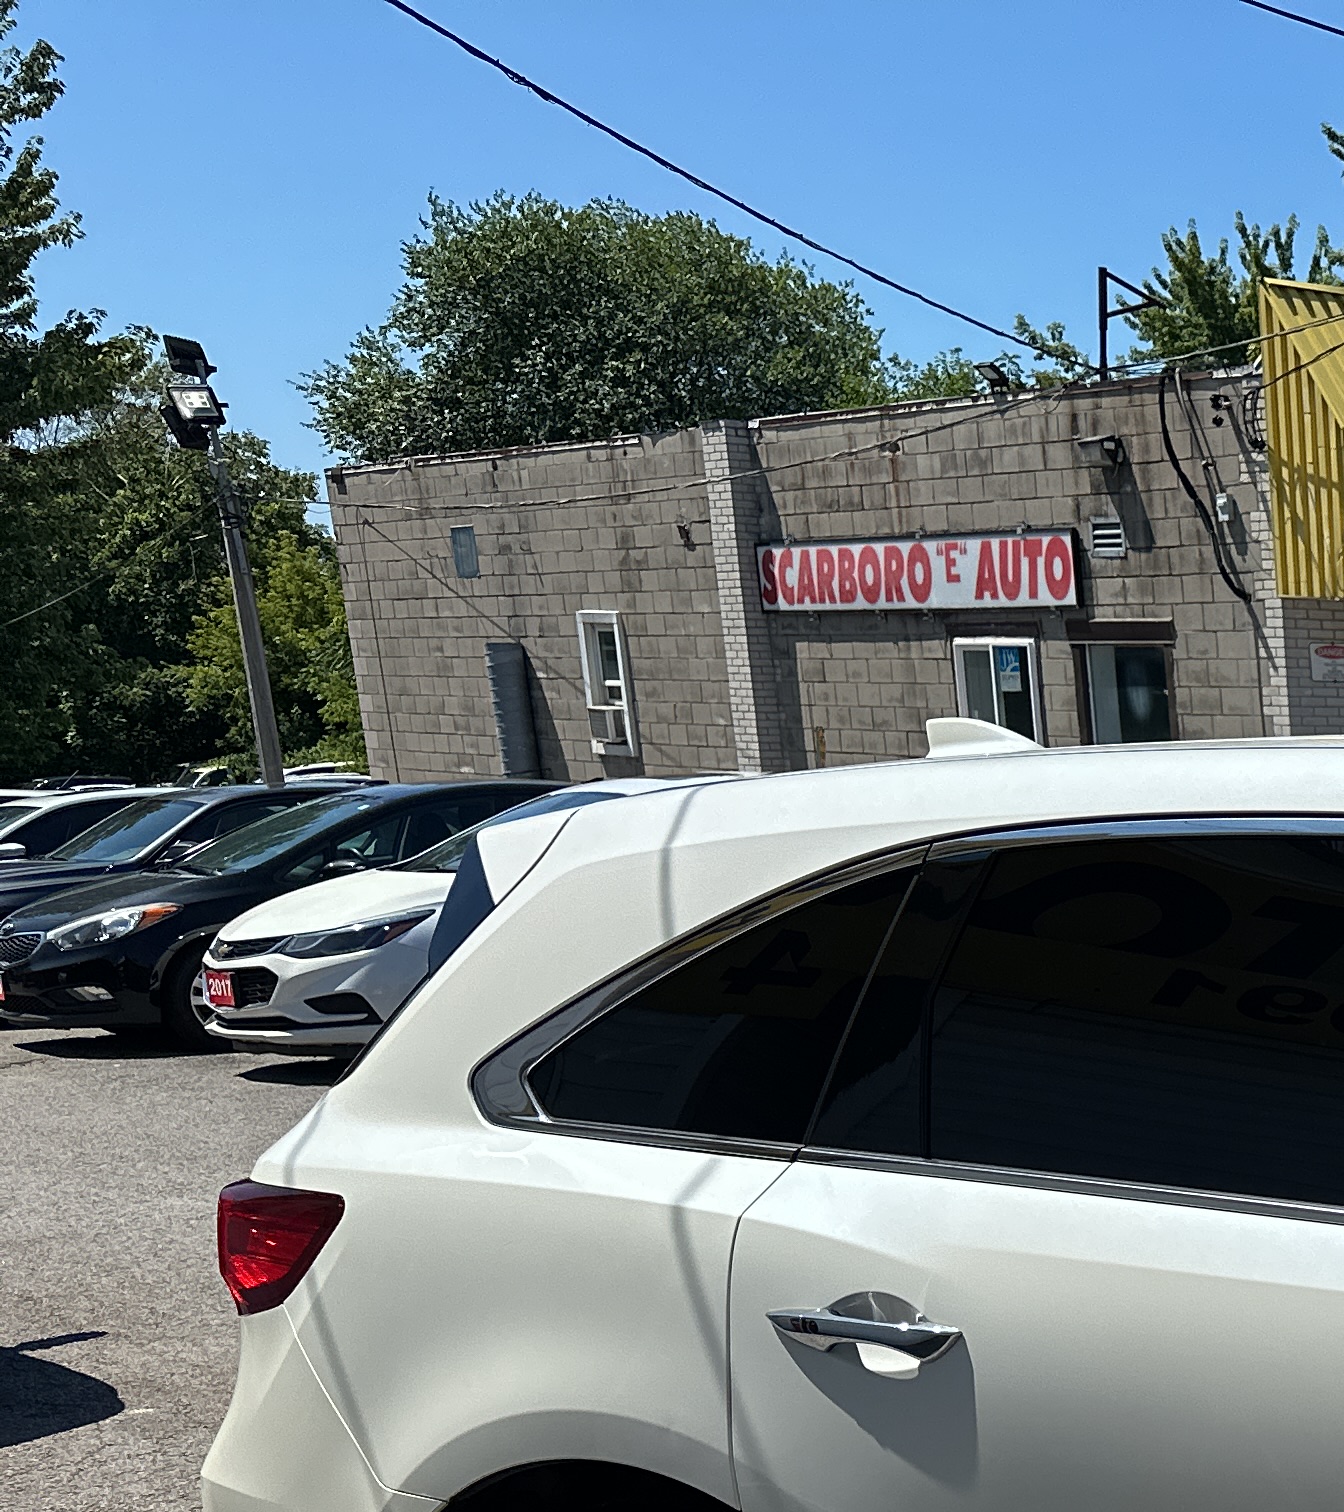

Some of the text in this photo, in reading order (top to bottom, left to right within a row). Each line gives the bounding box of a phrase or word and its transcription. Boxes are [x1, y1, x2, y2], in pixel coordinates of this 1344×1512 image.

[761, 542, 933, 606] SCARBORO
[974, 535, 1072, 601] AUTO
[208, 979, 232, 997] 2017
